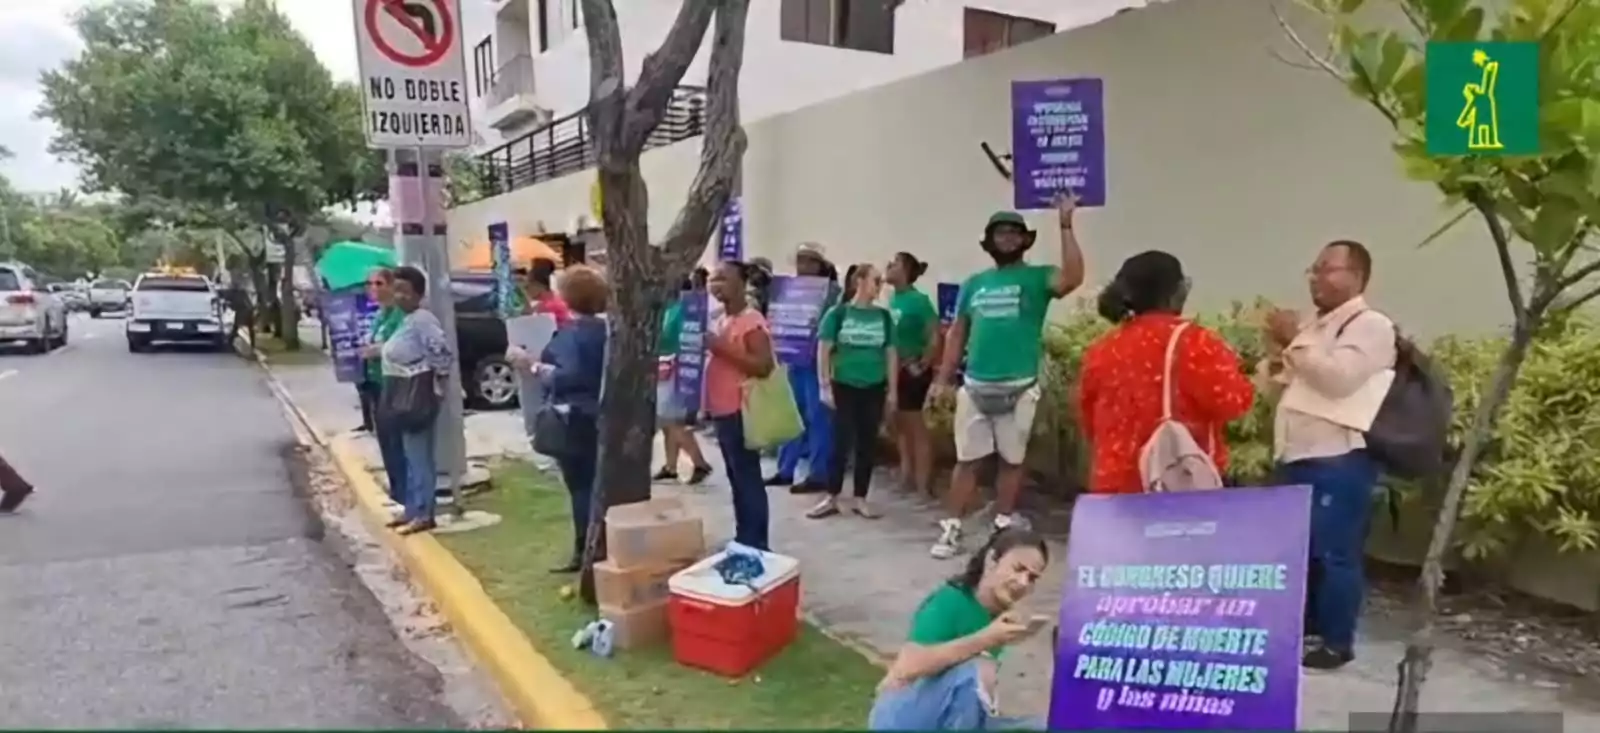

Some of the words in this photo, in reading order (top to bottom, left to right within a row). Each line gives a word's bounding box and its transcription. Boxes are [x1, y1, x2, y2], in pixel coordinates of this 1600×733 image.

[369, 77, 394, 99] NO
[405, 79, 460, 102] DOBLE
[371, 111, 464, 136] IZQUIERDA
[1078, 565, 1096, 588] EL
[1207, 564, 1287, 593] QUIERE
[1096, 592, 1210, 616] aprobar
[1215, 599, 1257, 616] un
[1078, 620, 1151, 650] CÓDIGO
[1151, 625, 1181, 650] DE
[1181, 626, 1269, 655] MUERTE
[1073, 654, 1125, 682] PARA
[1124, 657, 1165, 685] LAS
[1164, 660, 1269, 694] MUJERES
[1096, 687, 1114, 711] y
[1117, 685, 1156, 708] las
[1159, 689, 1236, 715] niñas
